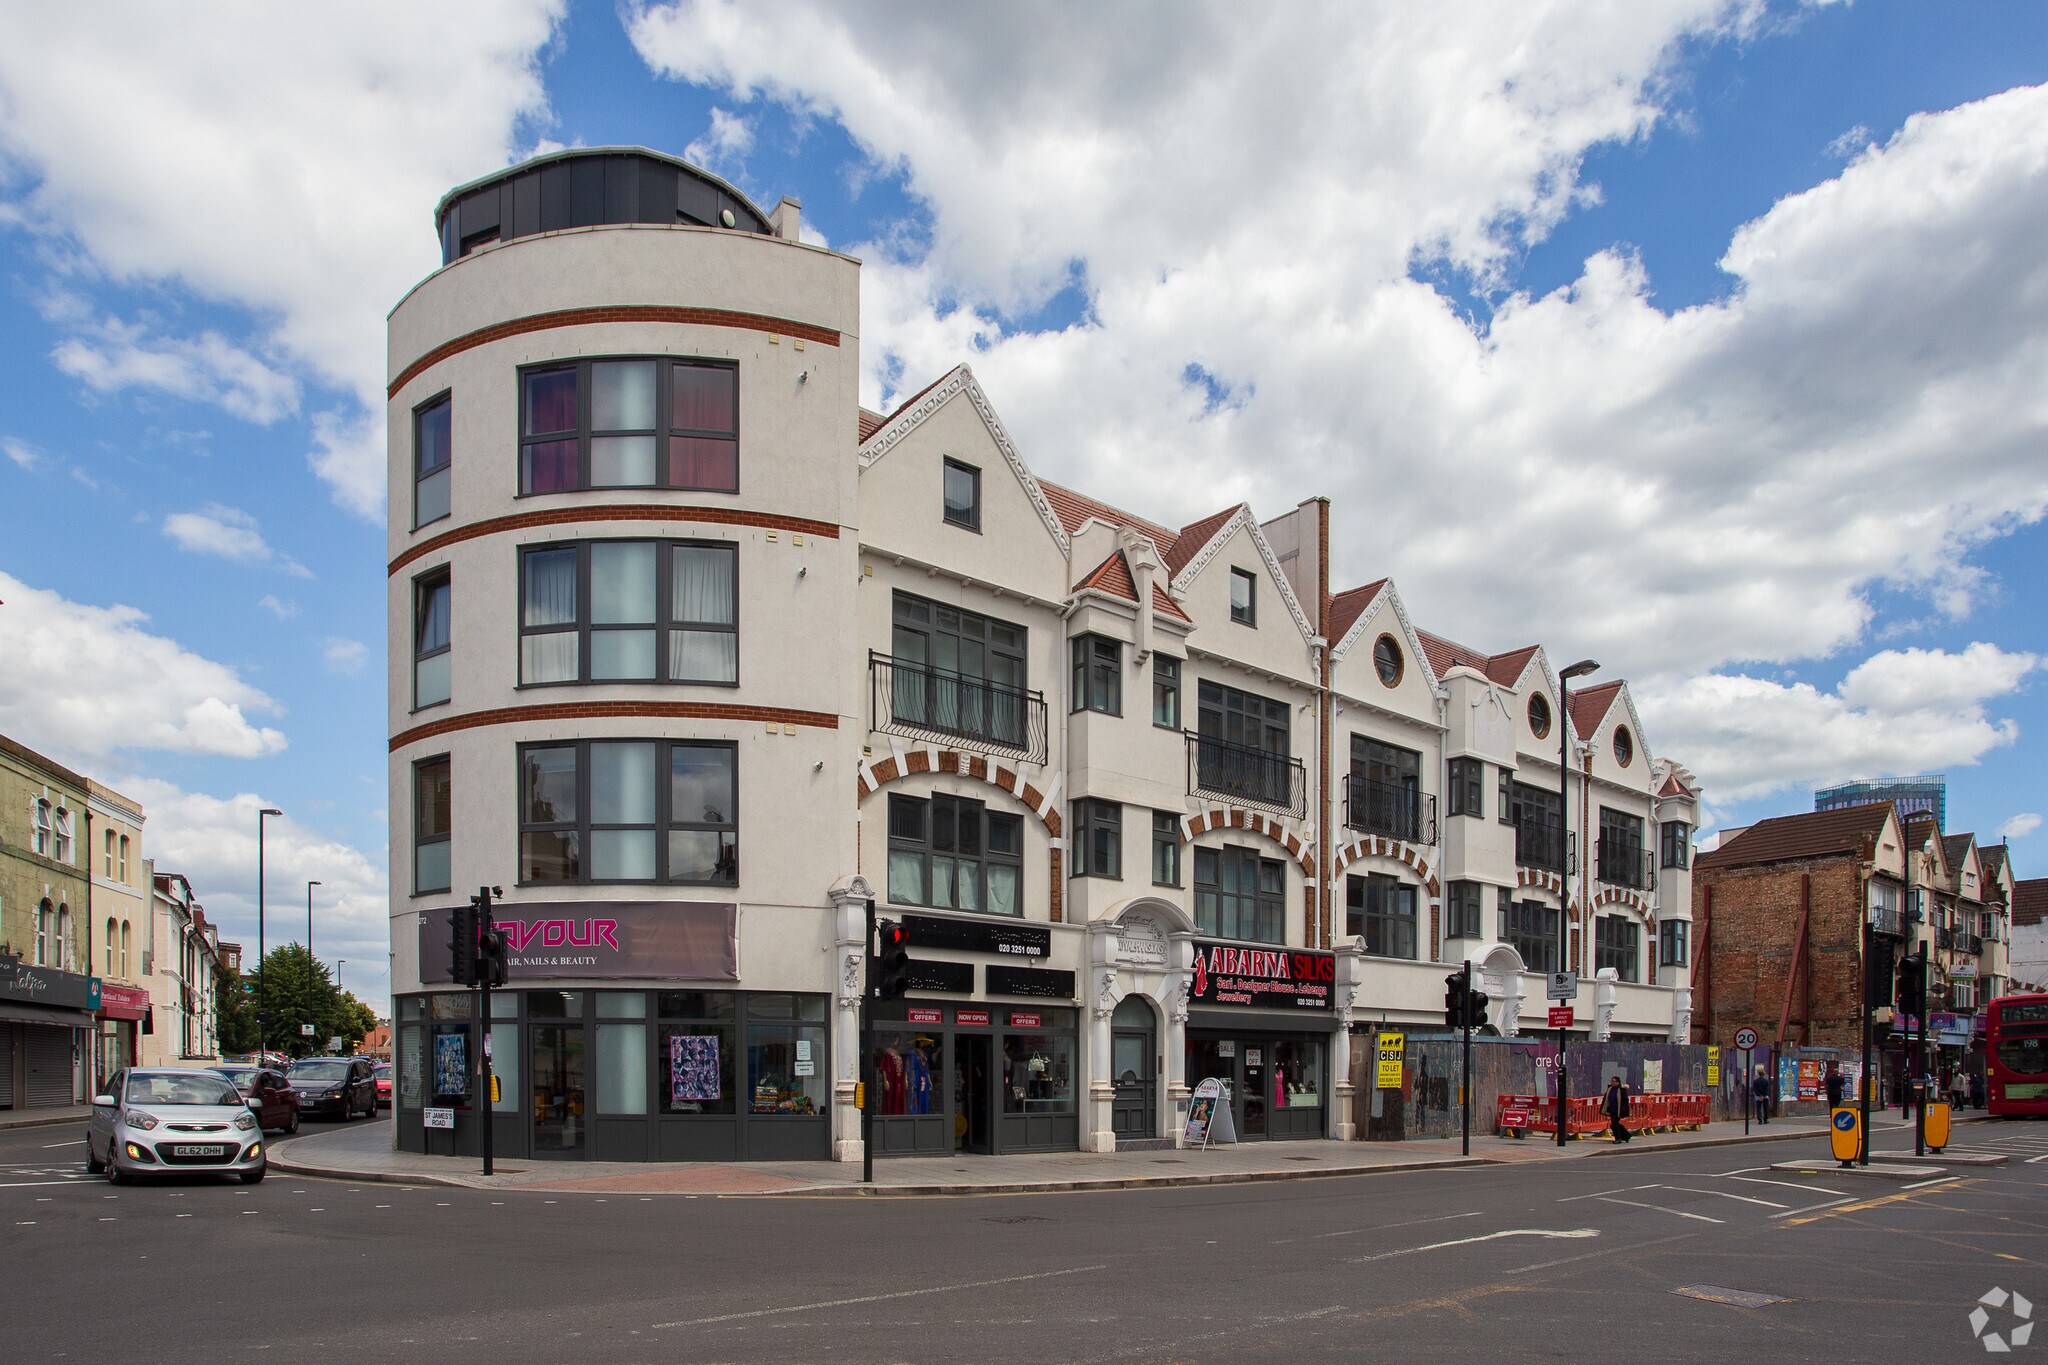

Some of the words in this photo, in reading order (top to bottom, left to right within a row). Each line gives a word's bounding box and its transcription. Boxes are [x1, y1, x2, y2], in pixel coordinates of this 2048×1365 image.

[999, 944, 1010, 953] 020
[1011, 946, 1025, 954] 3251
[1026, 946, 1041, 955] 0000
[523, 957, 549, 966] NAILS
[551, 957, 558, 965] &
[560, 956, 598, 965] BEAUTY
[1208, 946, 1291, 979] ABARNA
[1293, 954, 1335, 982] SILKS
[1217, 976, 1233, 990] Sari
[1238, 978, 1270, 994] Designer
[1271, 981, 1295, 994] Blouse
[1216, 990, 1252, 1005] Jewellery
[1738, 1034, 1756, 1044] 20
[2024, 1039, 2038, 1048] 198
[1220, 1045, 1234, 1053] SALE
[1380, 1051, 1402, 1060] CSJ
[1536, 1056, 1552, 1068] are
[432, 1119, 446, 1127] ROAD
[178, 1147, 201, 1155] GL62
